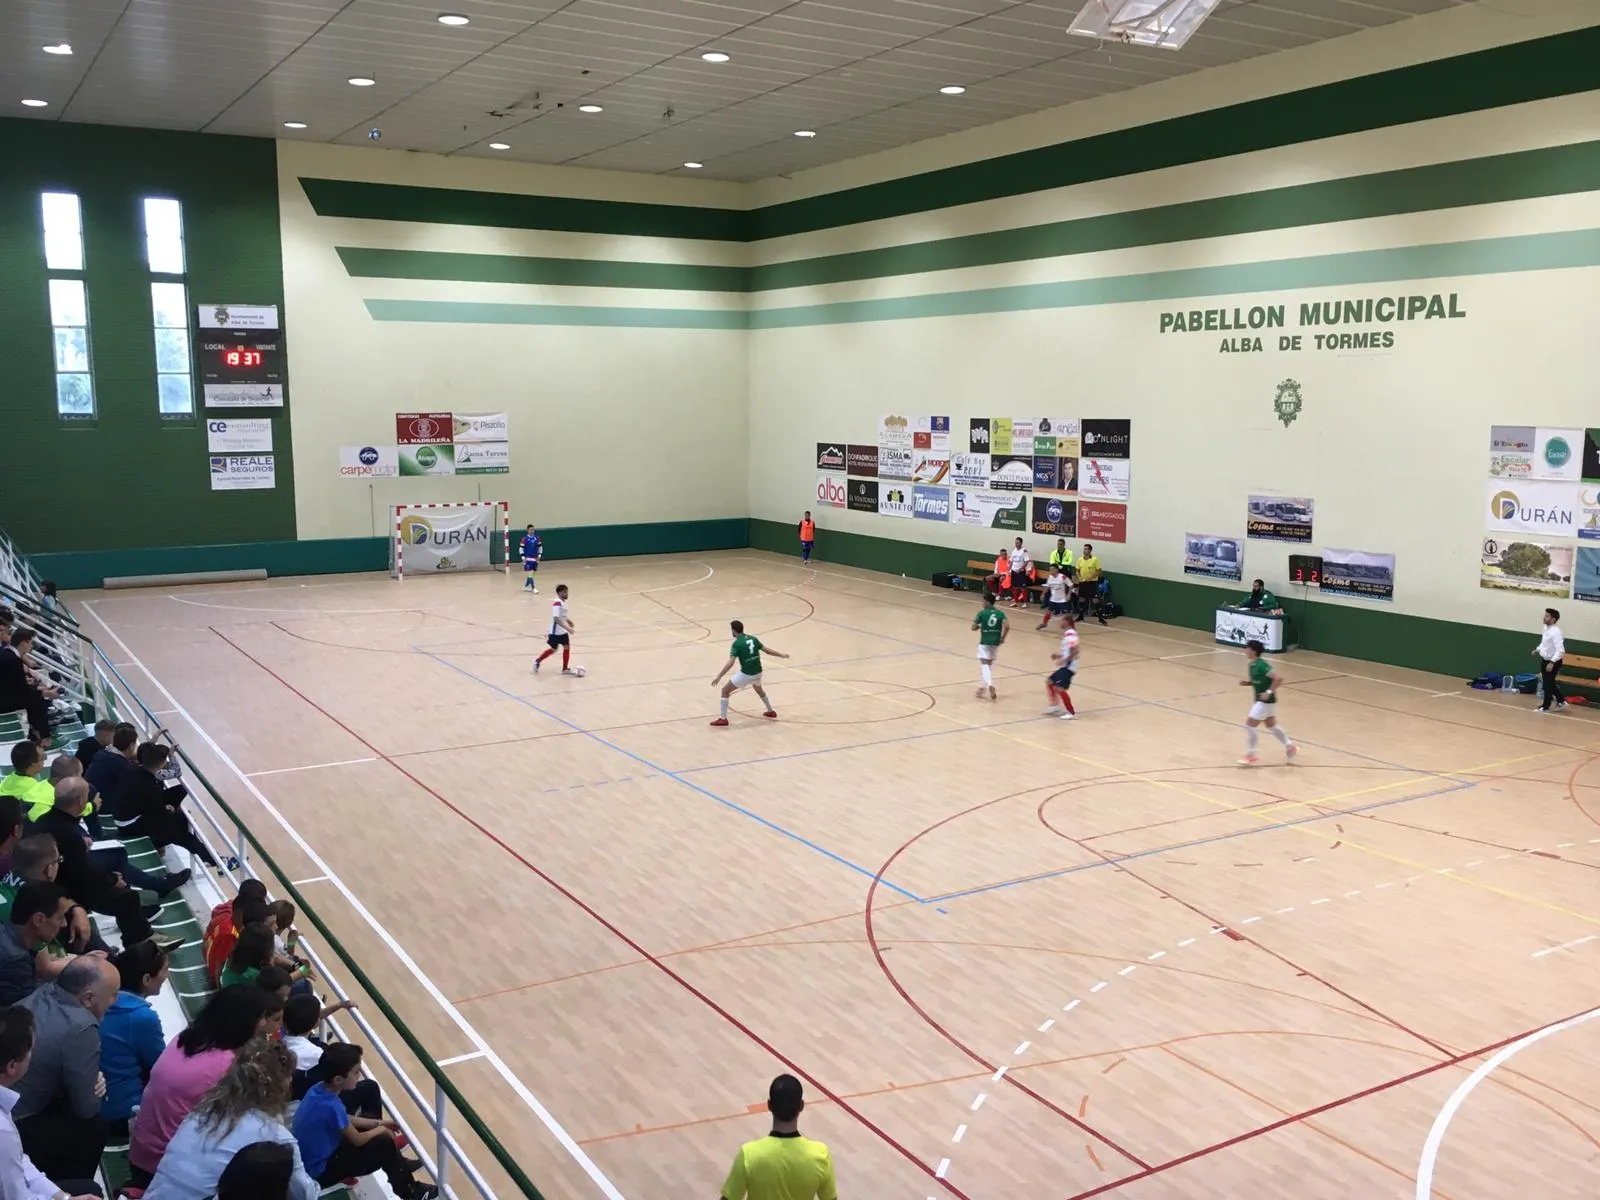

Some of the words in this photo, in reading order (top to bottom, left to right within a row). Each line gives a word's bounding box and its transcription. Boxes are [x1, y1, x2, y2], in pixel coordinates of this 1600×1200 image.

[1160, 305, 1285, 333] PABELLON
[1300, 293, 1466, 327] MUNICIPAL
[204, 343, 226, 351] LOCAL
[1219, 338, 1263, 353] ALBA
[1279, 336, 1302, 351] DE
[1314, 331, 1395, 350] TORMES
[230, 456, 273, 466] REALE
[818, 477, 846, 503] alba
[914, 493, 949, 516] Tormes
[1501, 498, 1573, 525] DURÁN
[1248, 520, 1274, 531] Cosme
[411, 522, 488, 546] DURÁN
[1296, 569, 1303, 581] 3
[1311, 571, 1318, 582] 2
[1322, 574, 1350, 586] Cosme
[987, 613, 998, 627] 6
[746, 639, 755, 654] 7
